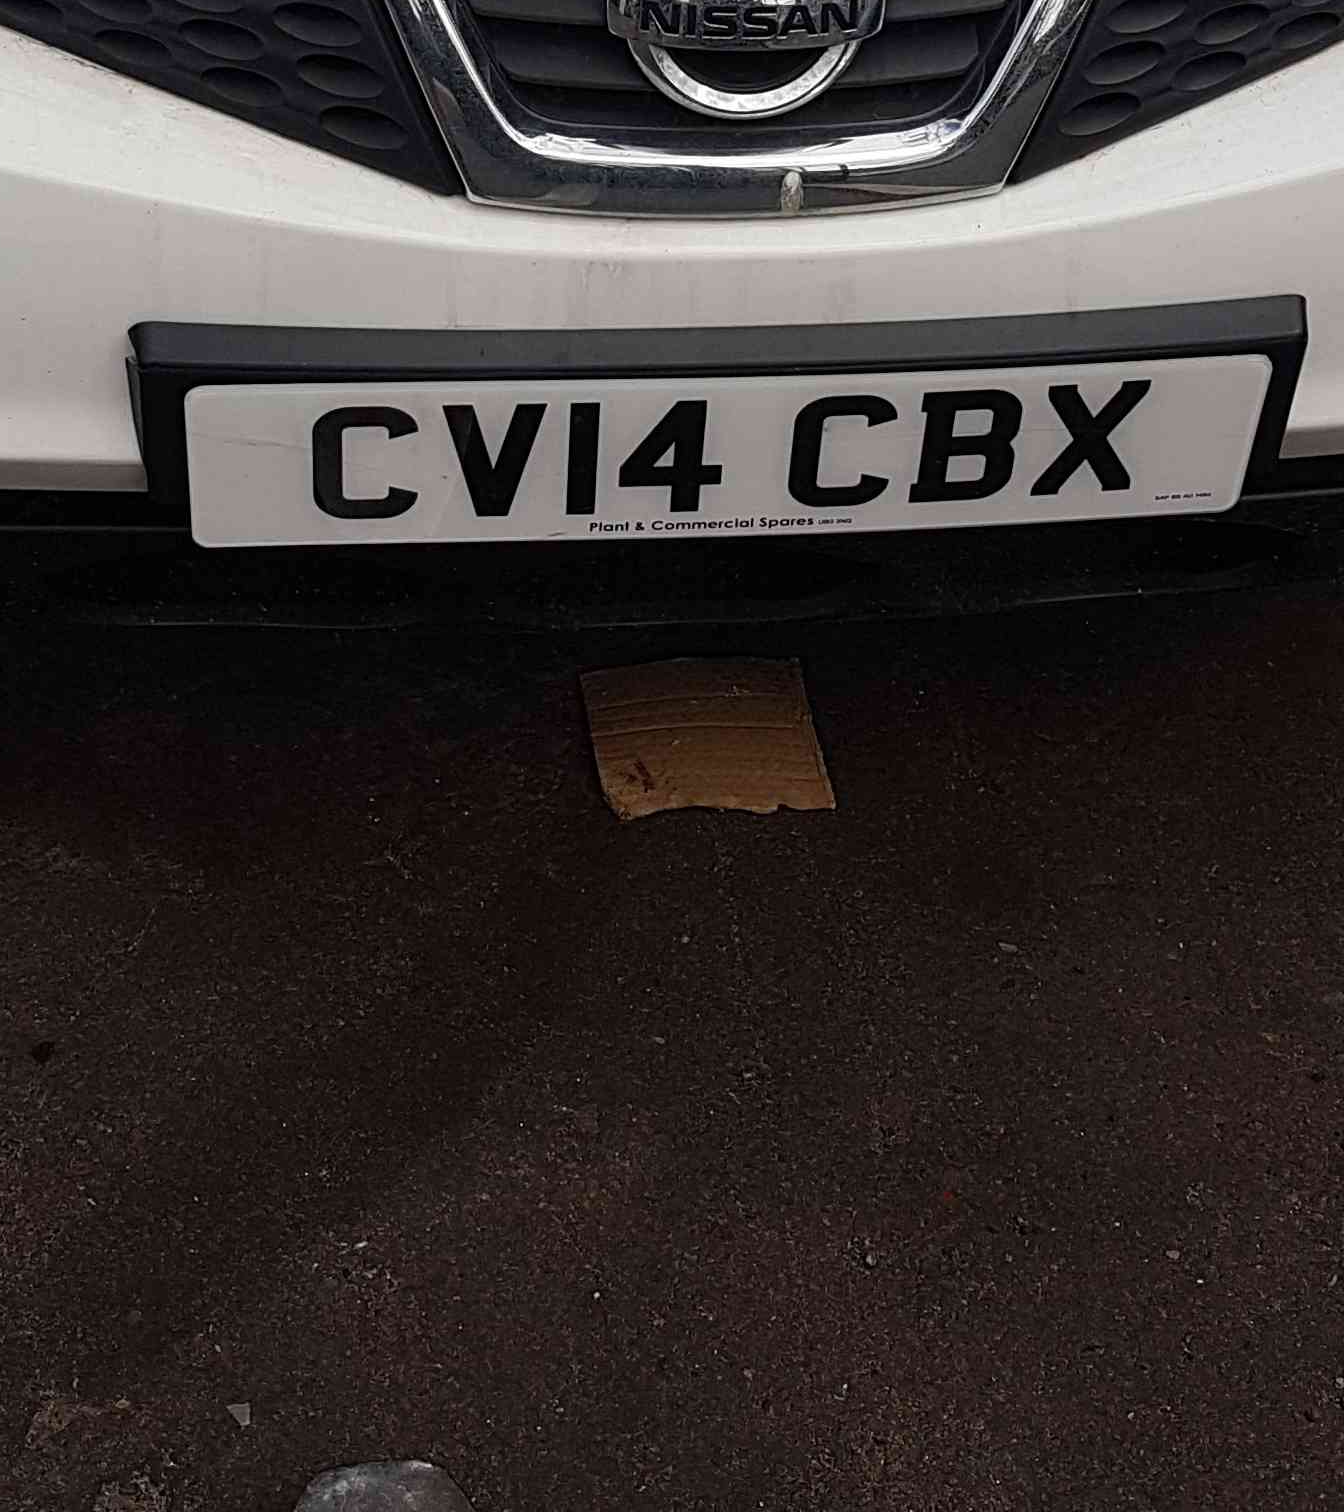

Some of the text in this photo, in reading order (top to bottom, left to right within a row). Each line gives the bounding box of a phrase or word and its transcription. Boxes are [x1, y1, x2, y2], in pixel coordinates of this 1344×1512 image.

[639, 1, 857, 39] NISSAN
[312, 380, 1152, 519] CV14 CBX
[589, 521, 629, 532] Plant
[635, 521, 645, 531] &
[651, 517, 754, 530] Commercial
[759, 516, 814, 529] Spares
